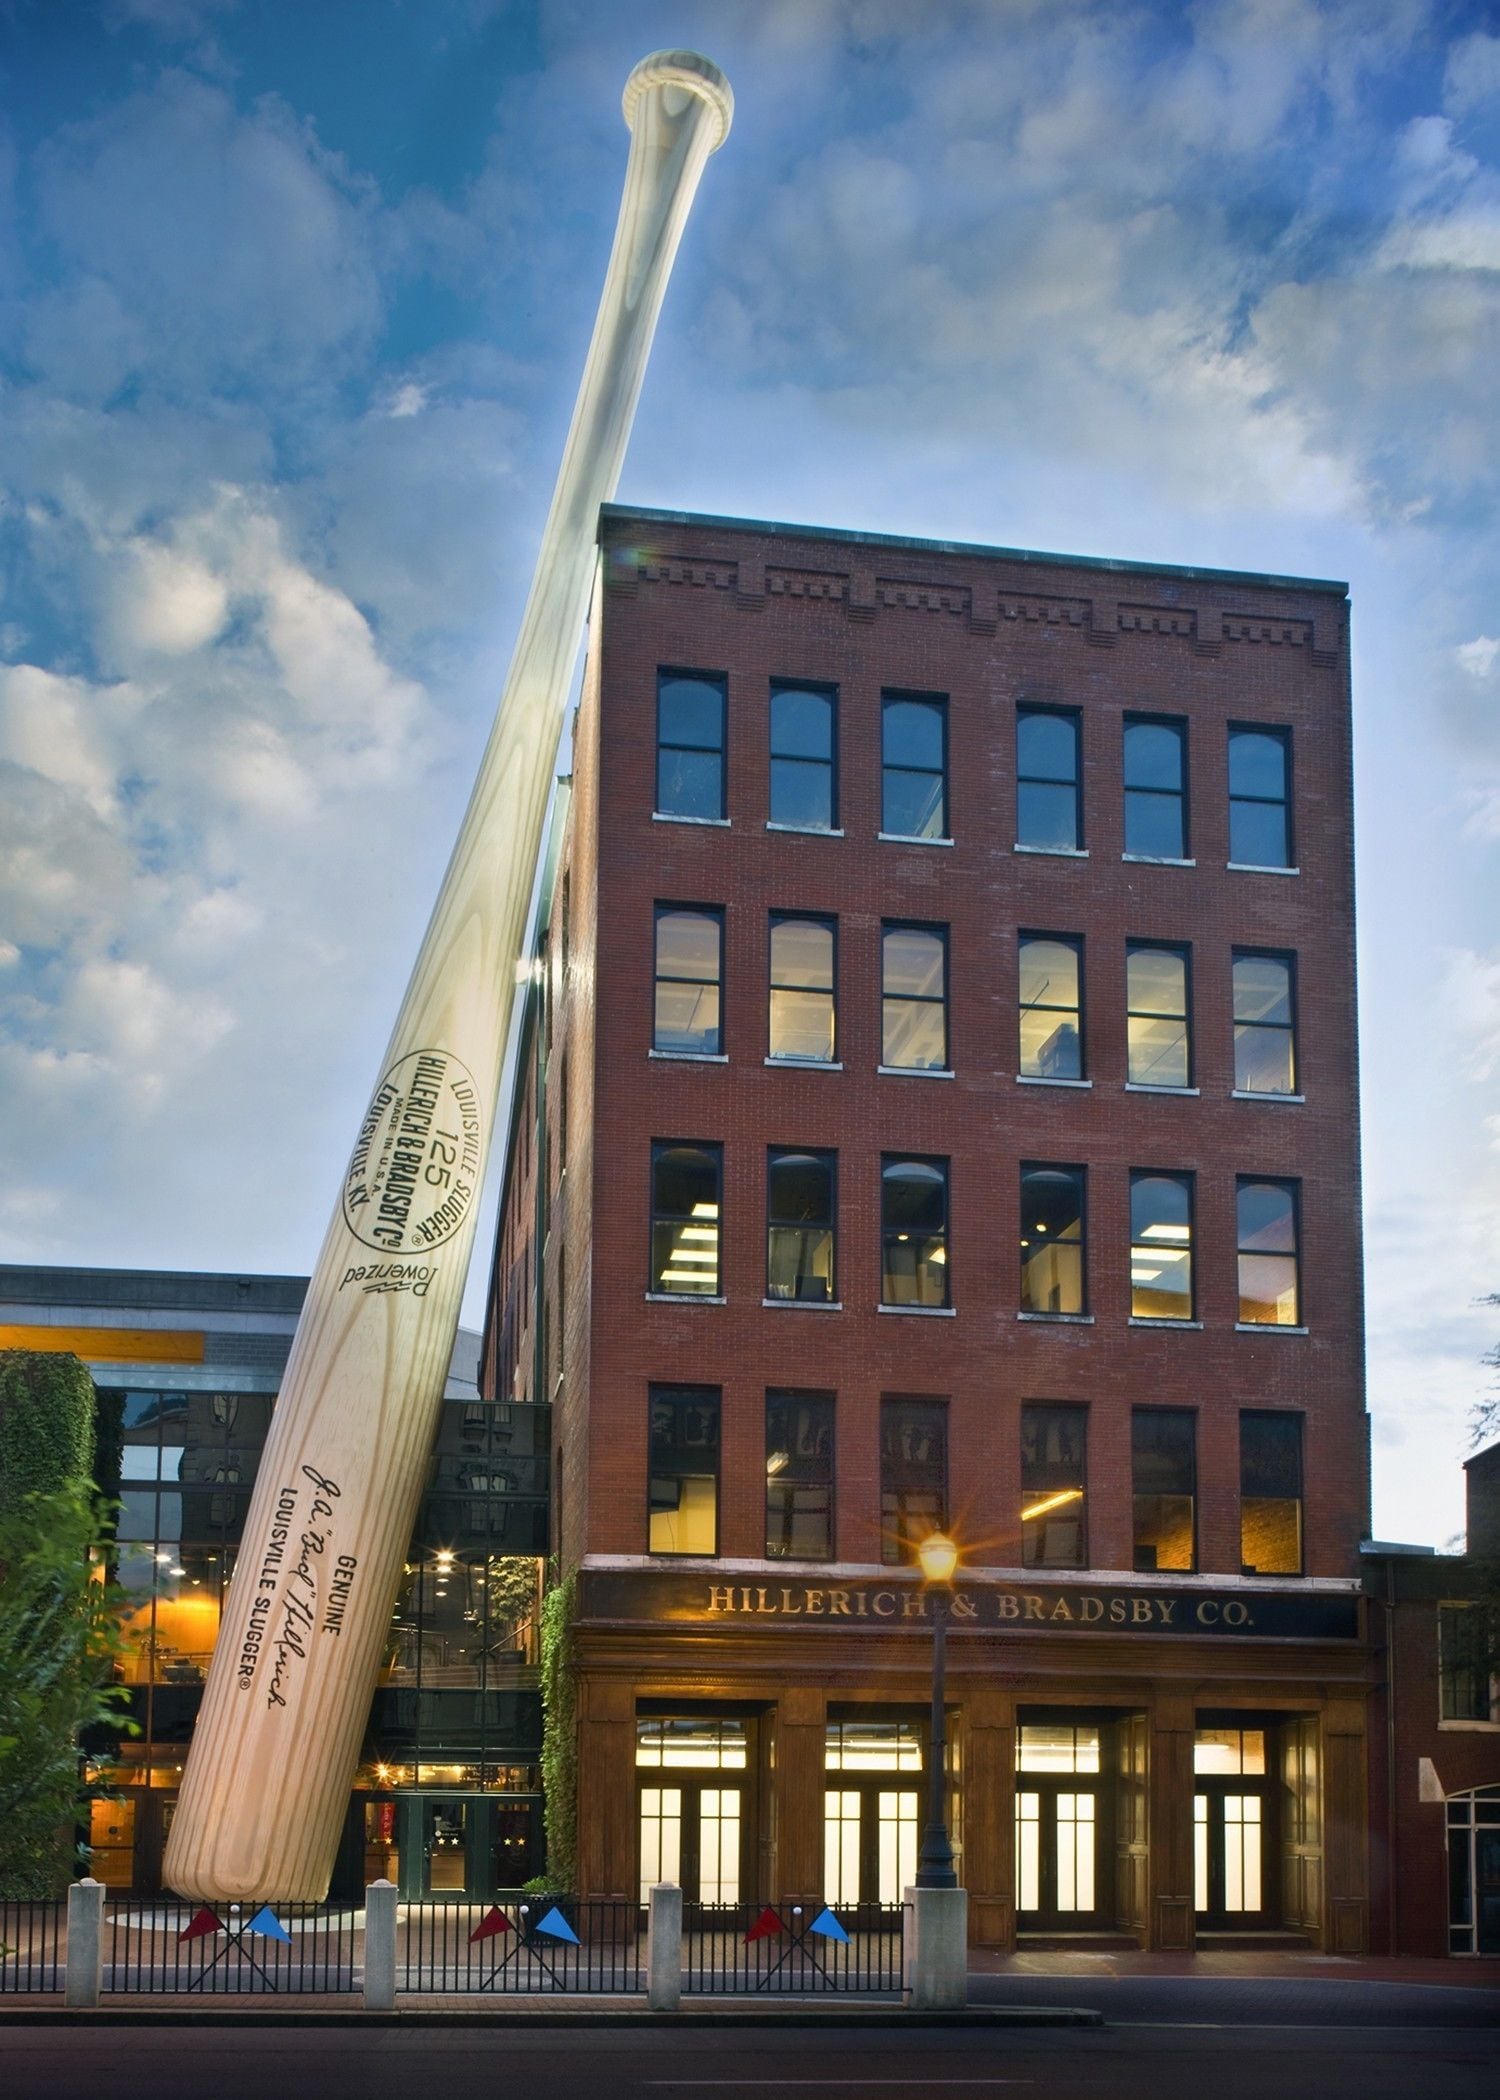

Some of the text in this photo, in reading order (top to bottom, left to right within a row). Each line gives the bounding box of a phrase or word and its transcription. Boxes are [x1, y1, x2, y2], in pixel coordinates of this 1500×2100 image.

[400, 1056, 447, 1136] HILLERICH
[450, 1079, 479, 1178] LOUISVILLE
[371, 1097, 404, 1197] MADE IN U.S.A.
[397, 1136, 425, 1151] &
[424, 1129, 459, 1189] 125
[348, 1183, 370, 1213] KY.
[377, 1151, 422, 1230] BRADSBY
[338, 1264, 438, 1297] Powerized
[259, 1487, 298, 1591] LOUISVILLE
[322, 1555, 357, 1637] GENUINE
[707, 1586, 1255, 1626] HILLERICH & BRADSBY CO.
[267, 1588, 314, 1710] Hillerich
